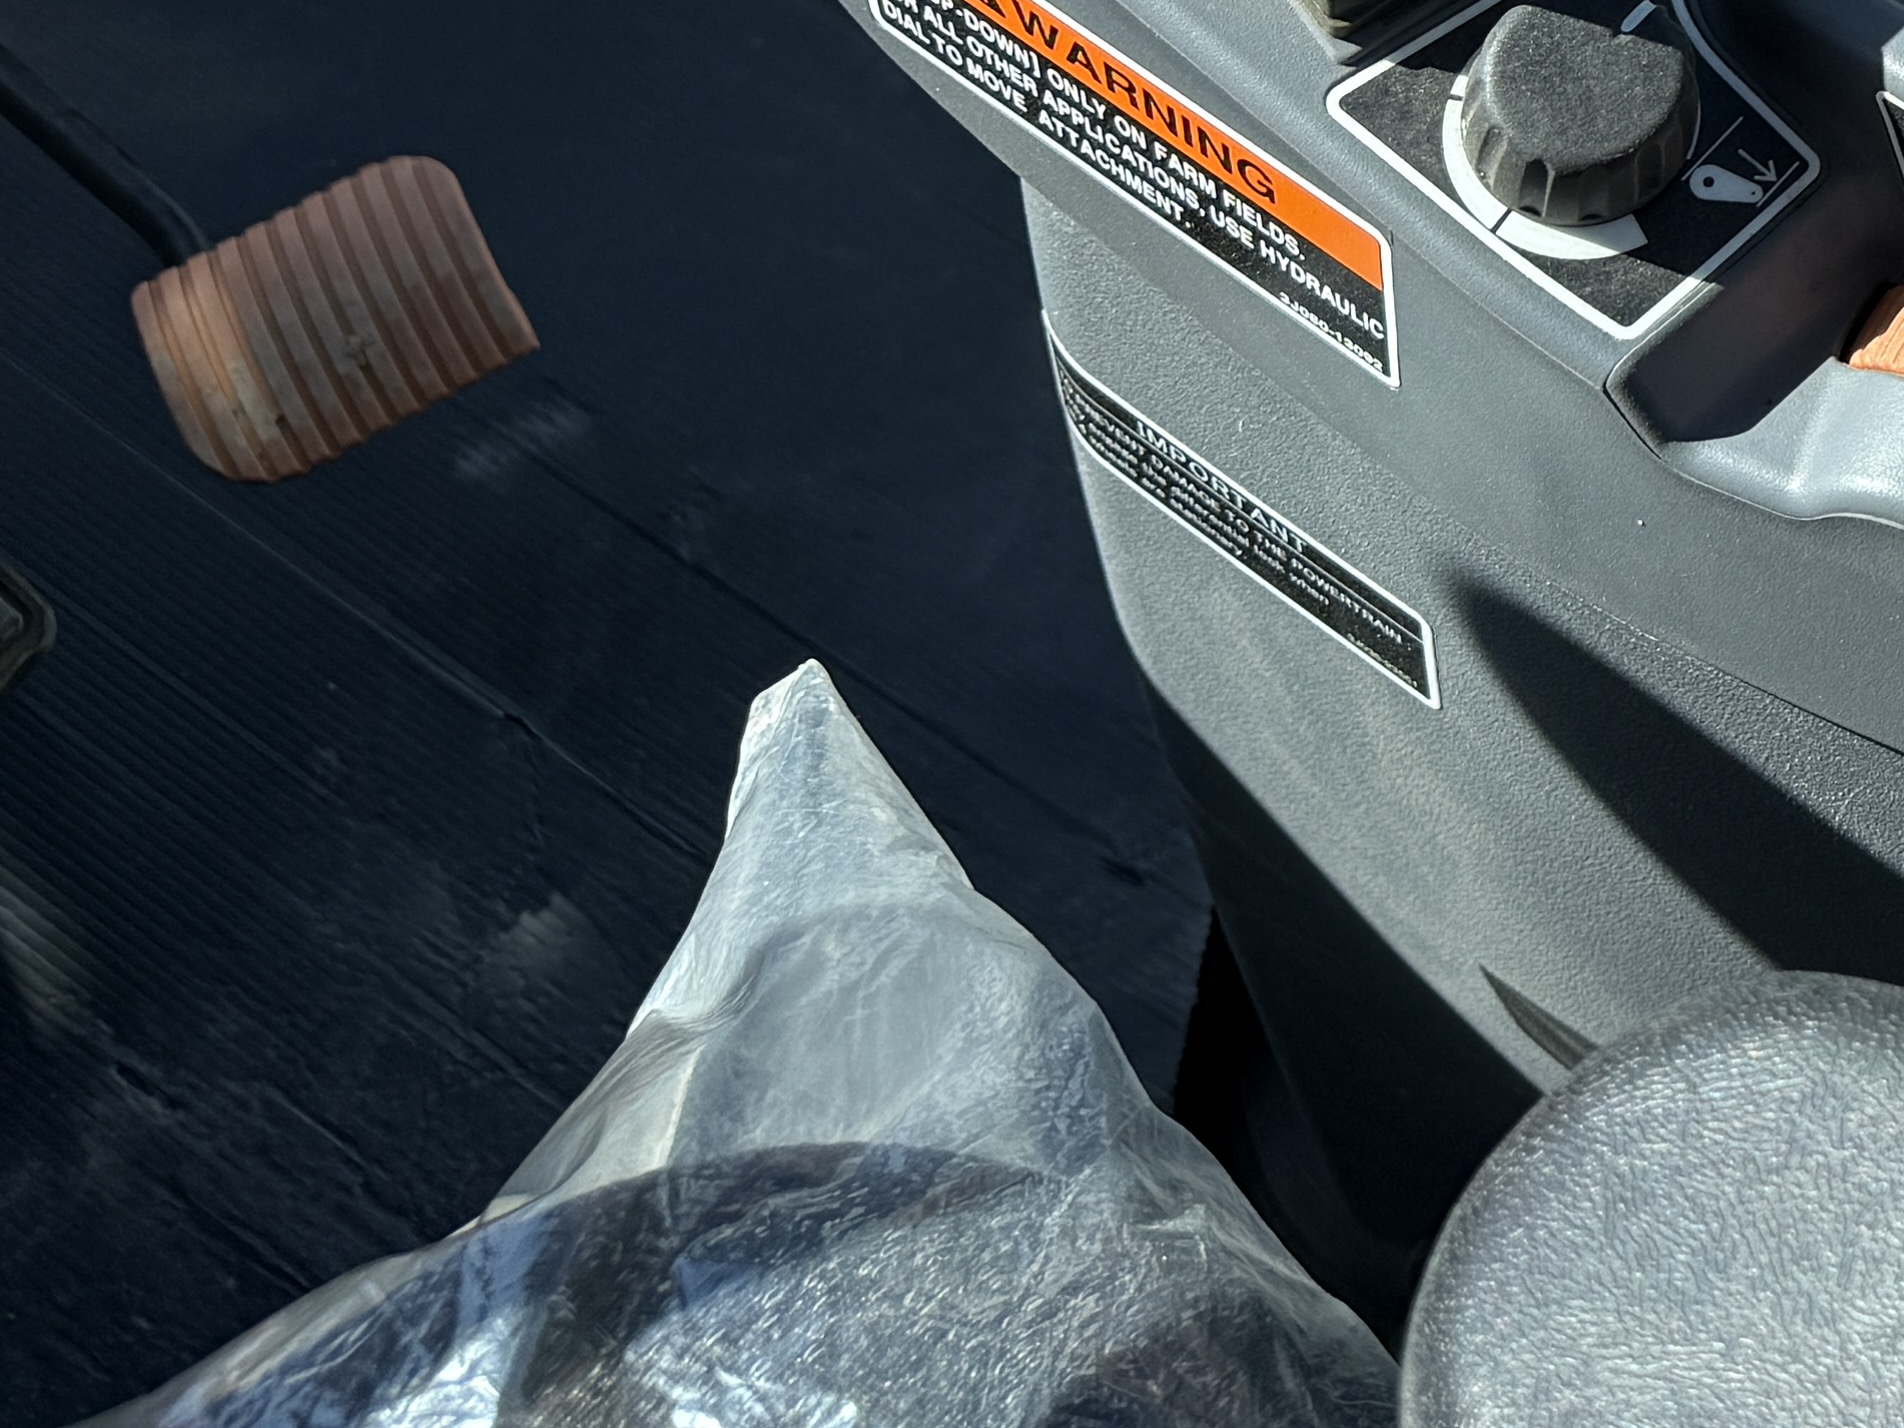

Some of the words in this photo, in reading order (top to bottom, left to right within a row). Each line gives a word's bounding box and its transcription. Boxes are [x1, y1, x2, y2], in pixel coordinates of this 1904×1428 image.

[924, 7, 964, 44] ALL
[966, 36, 1038, 97] OTHER
[1043, 89, 1206, 218] APPLICATIONS.
[1210, 205, 1255, 250] USE
[1260, 239, 1385, 340] HYDRAULIC
[932, 31, 964, 66] TO
[966, 57, 1027, 113] MOVE
[1038, 110, 1192, 229] ATTACHMENT.
[1047, 68, 1106, 120] ONLY
[1115, 114, 1147, 150] ON
[1154, 142, 1216, 199] FARM
[1223, 189, 1305, 261] FIELDS.
[1137, 421, 1307, 554] IMPORTANT
[1225, 508, 1250, 534] TO
